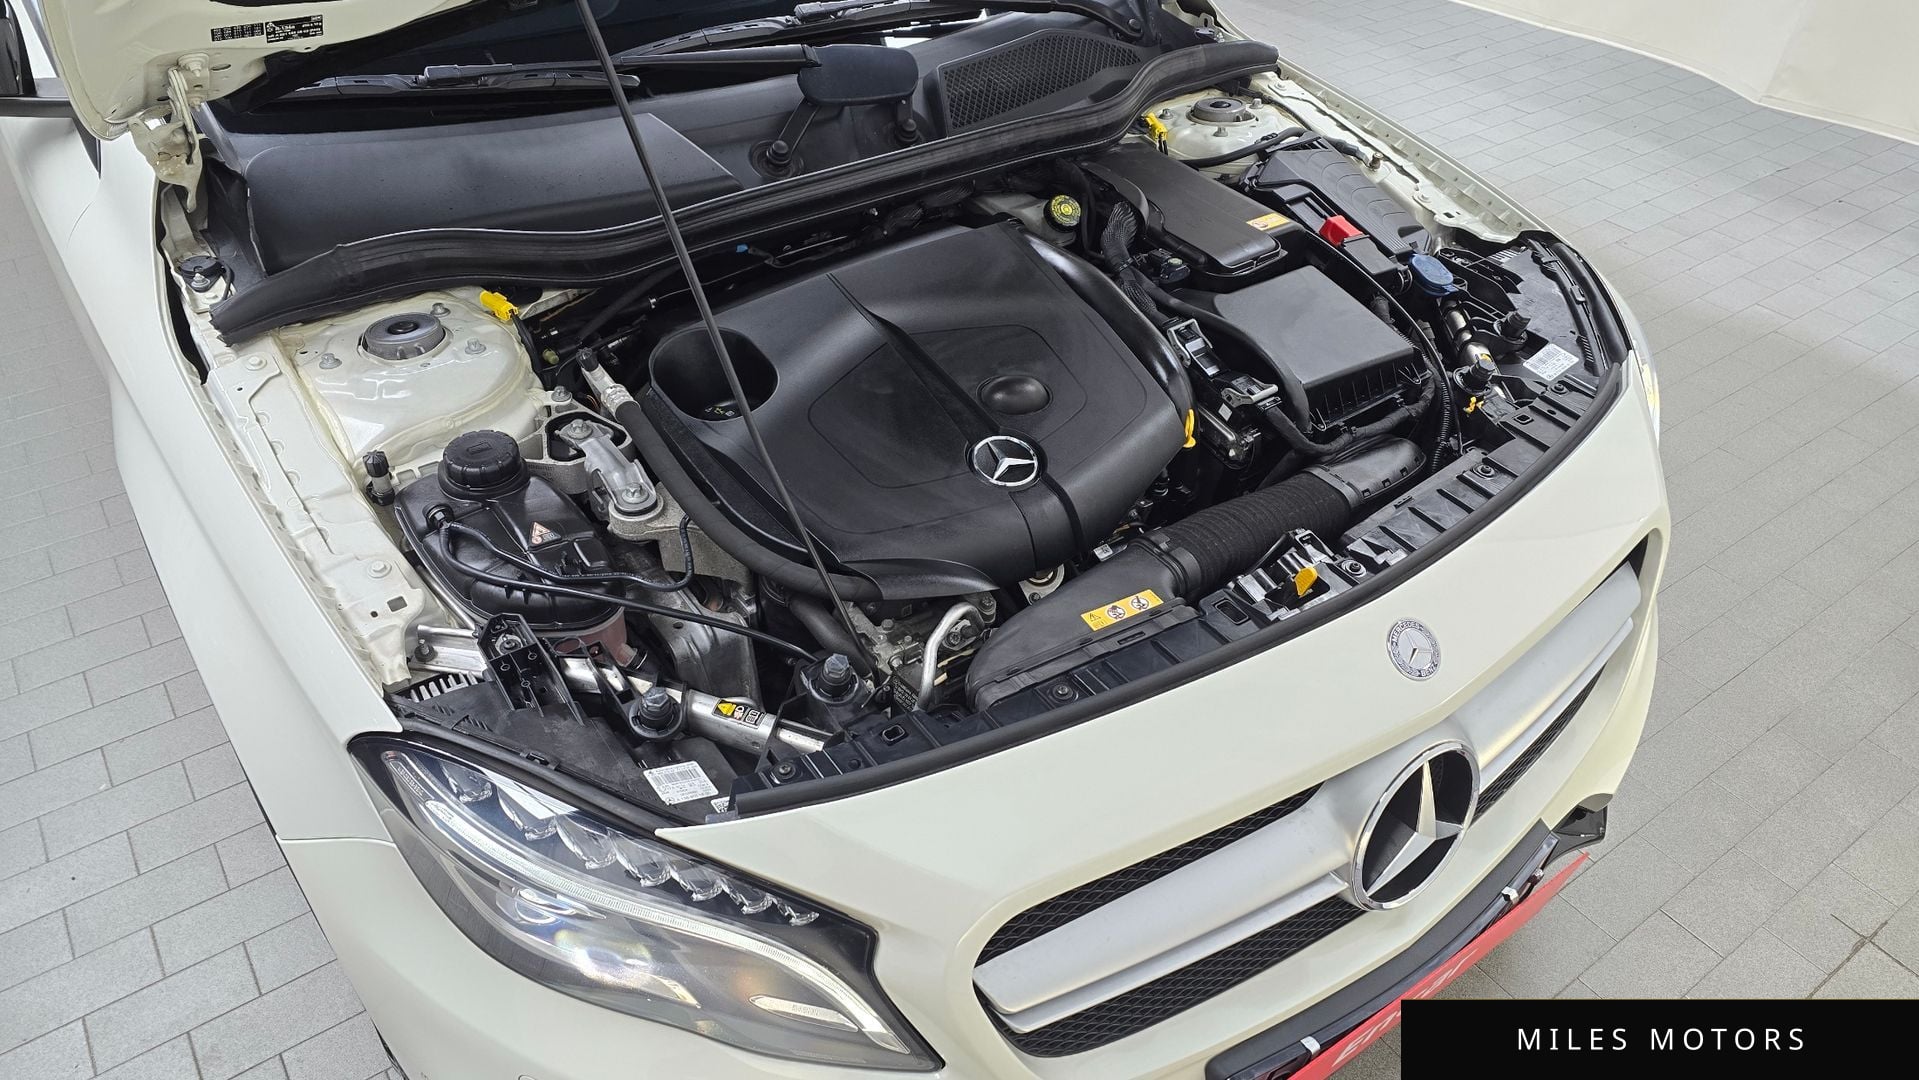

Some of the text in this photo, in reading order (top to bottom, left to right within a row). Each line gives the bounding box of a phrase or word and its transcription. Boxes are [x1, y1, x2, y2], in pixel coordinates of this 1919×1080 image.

[1391, 620, 1421, 643] MERCEDES
[1421, 660, 1438, 677] BENZ
[1332, 947, 1479, 1068] Enar
